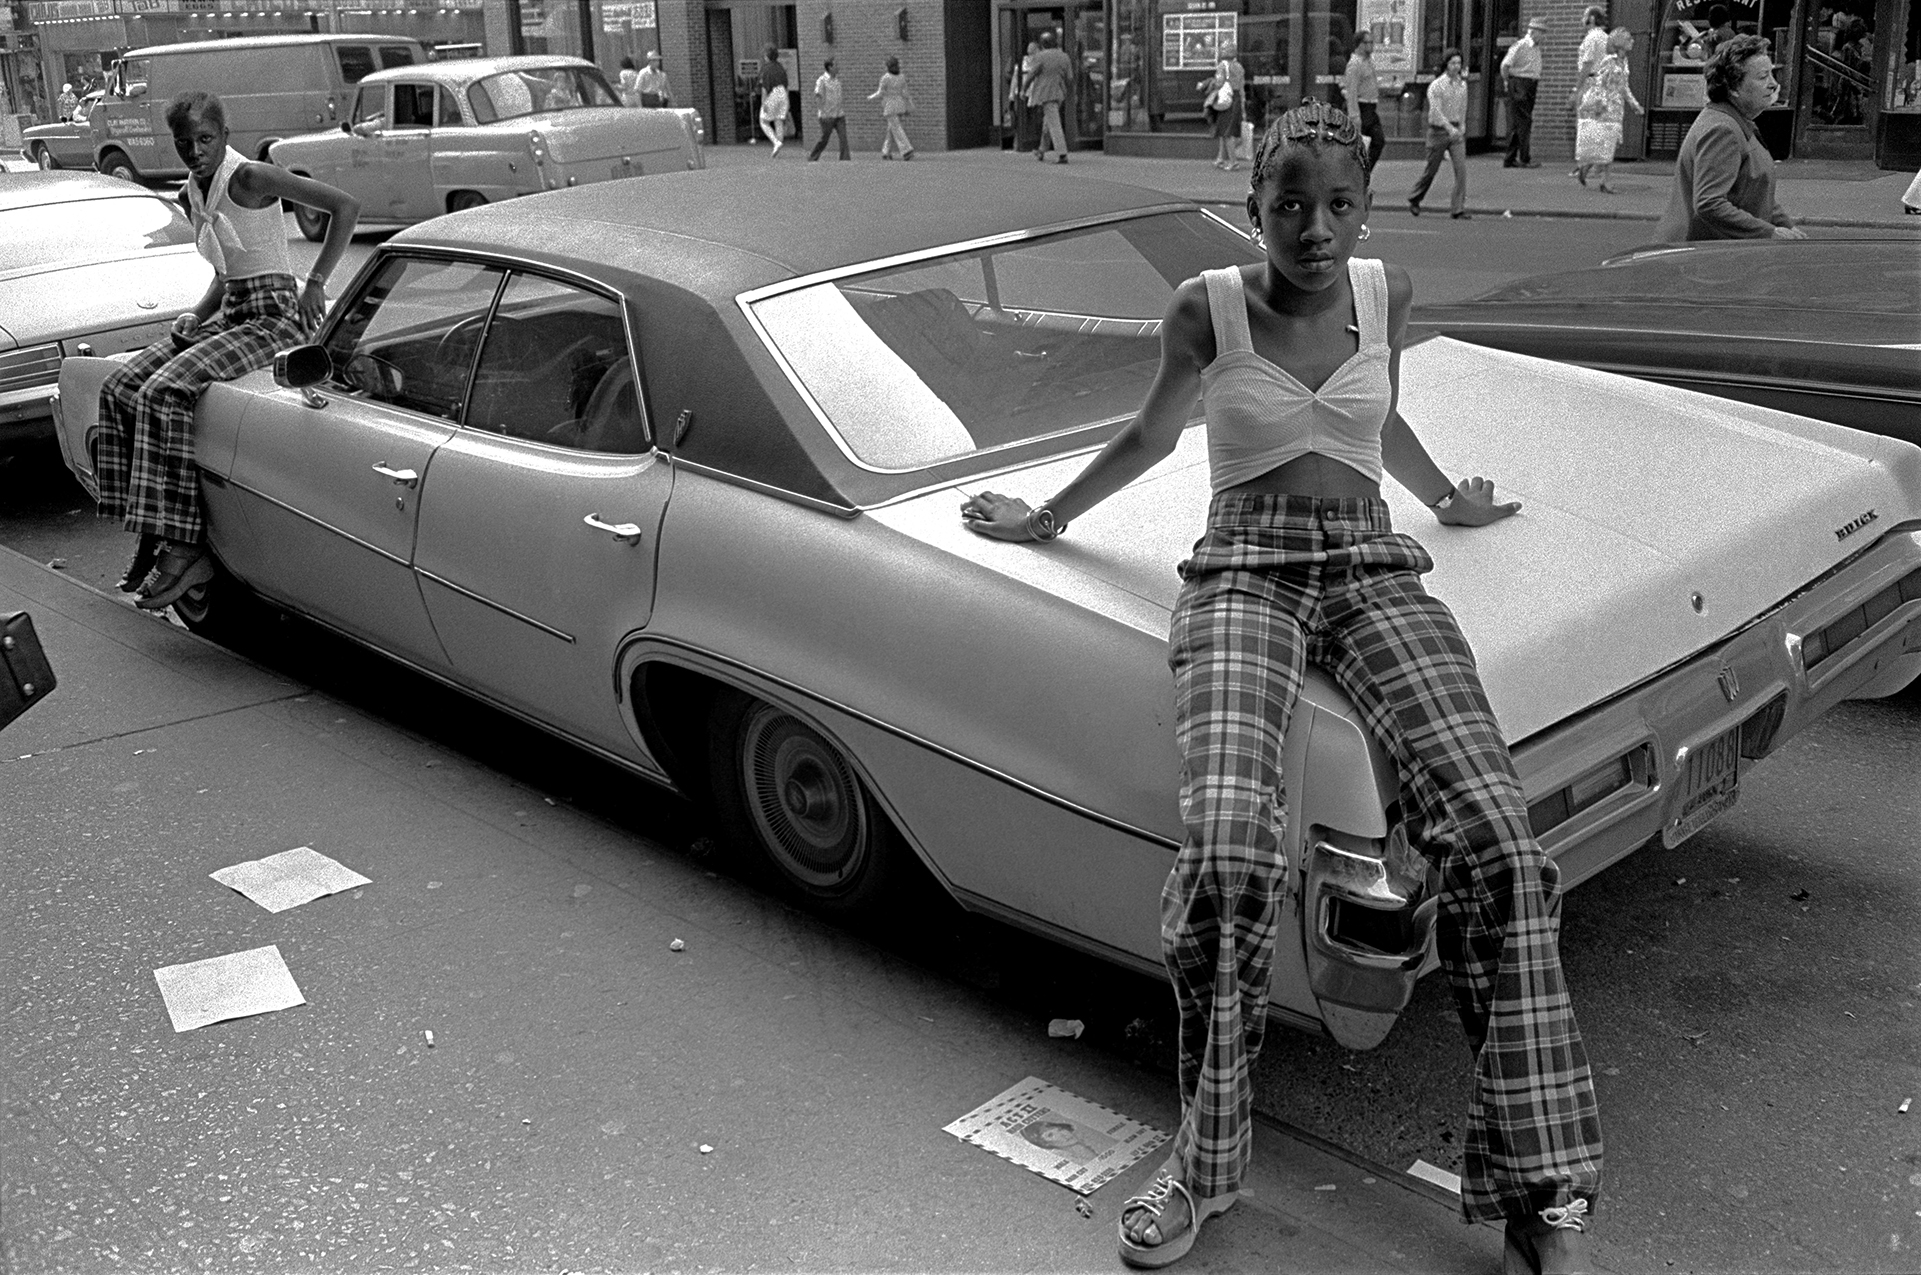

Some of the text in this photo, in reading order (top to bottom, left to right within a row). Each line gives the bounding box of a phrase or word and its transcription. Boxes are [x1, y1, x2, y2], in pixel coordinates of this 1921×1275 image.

[1834, 509, 1879, 542] BUICK
[1000, 1104, 1038, 1128] ACT II
[1021, 1107, 1051, 1125] CUTTERS
